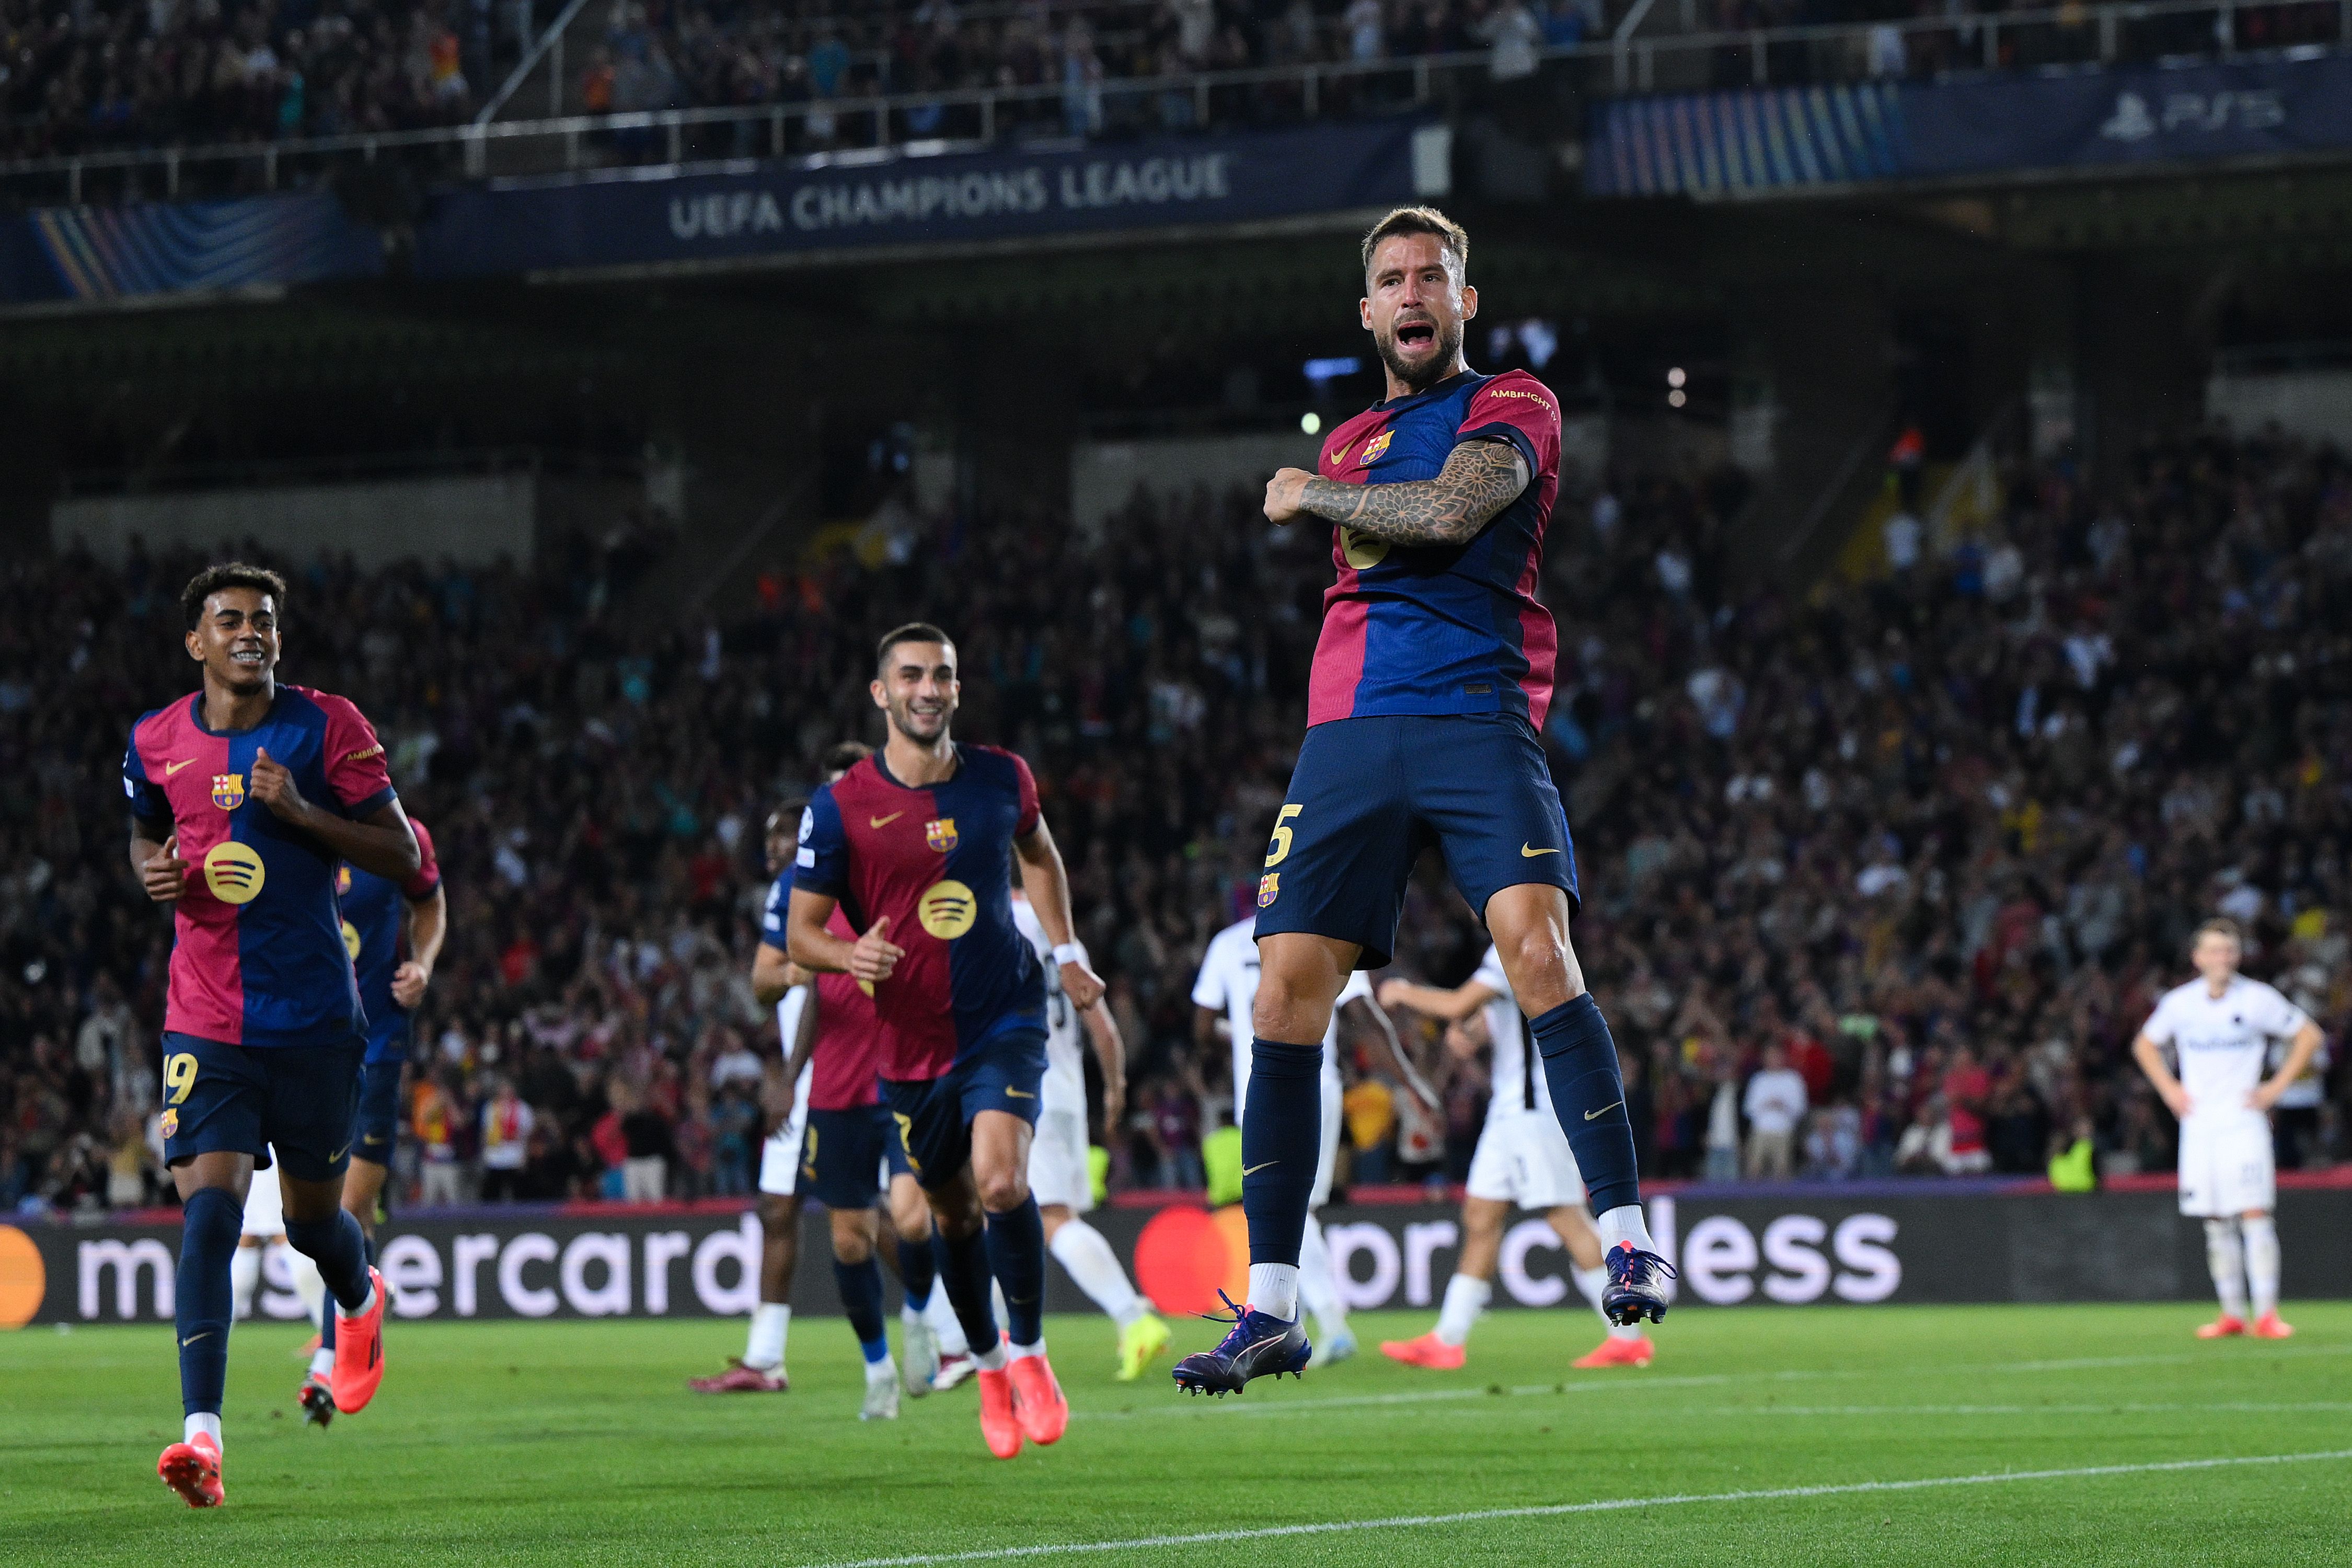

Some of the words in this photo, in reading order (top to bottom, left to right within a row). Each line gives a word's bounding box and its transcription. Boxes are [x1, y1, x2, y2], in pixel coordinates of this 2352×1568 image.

[2162, 90, 2287, 132] PS5
[669, 193, 784, 240] UEFA
[790, 166, 1047, 233] CHAMPIONS
[1059, 152, 1232, 209] LEAGUE
[1490, 390, 1551, 410] AMBILIGHT
[1265, 804, 1304, 868] 5
[78, 1212, 765, 1319] msercard
[1322, 1195, 1903, 1311] prcless
